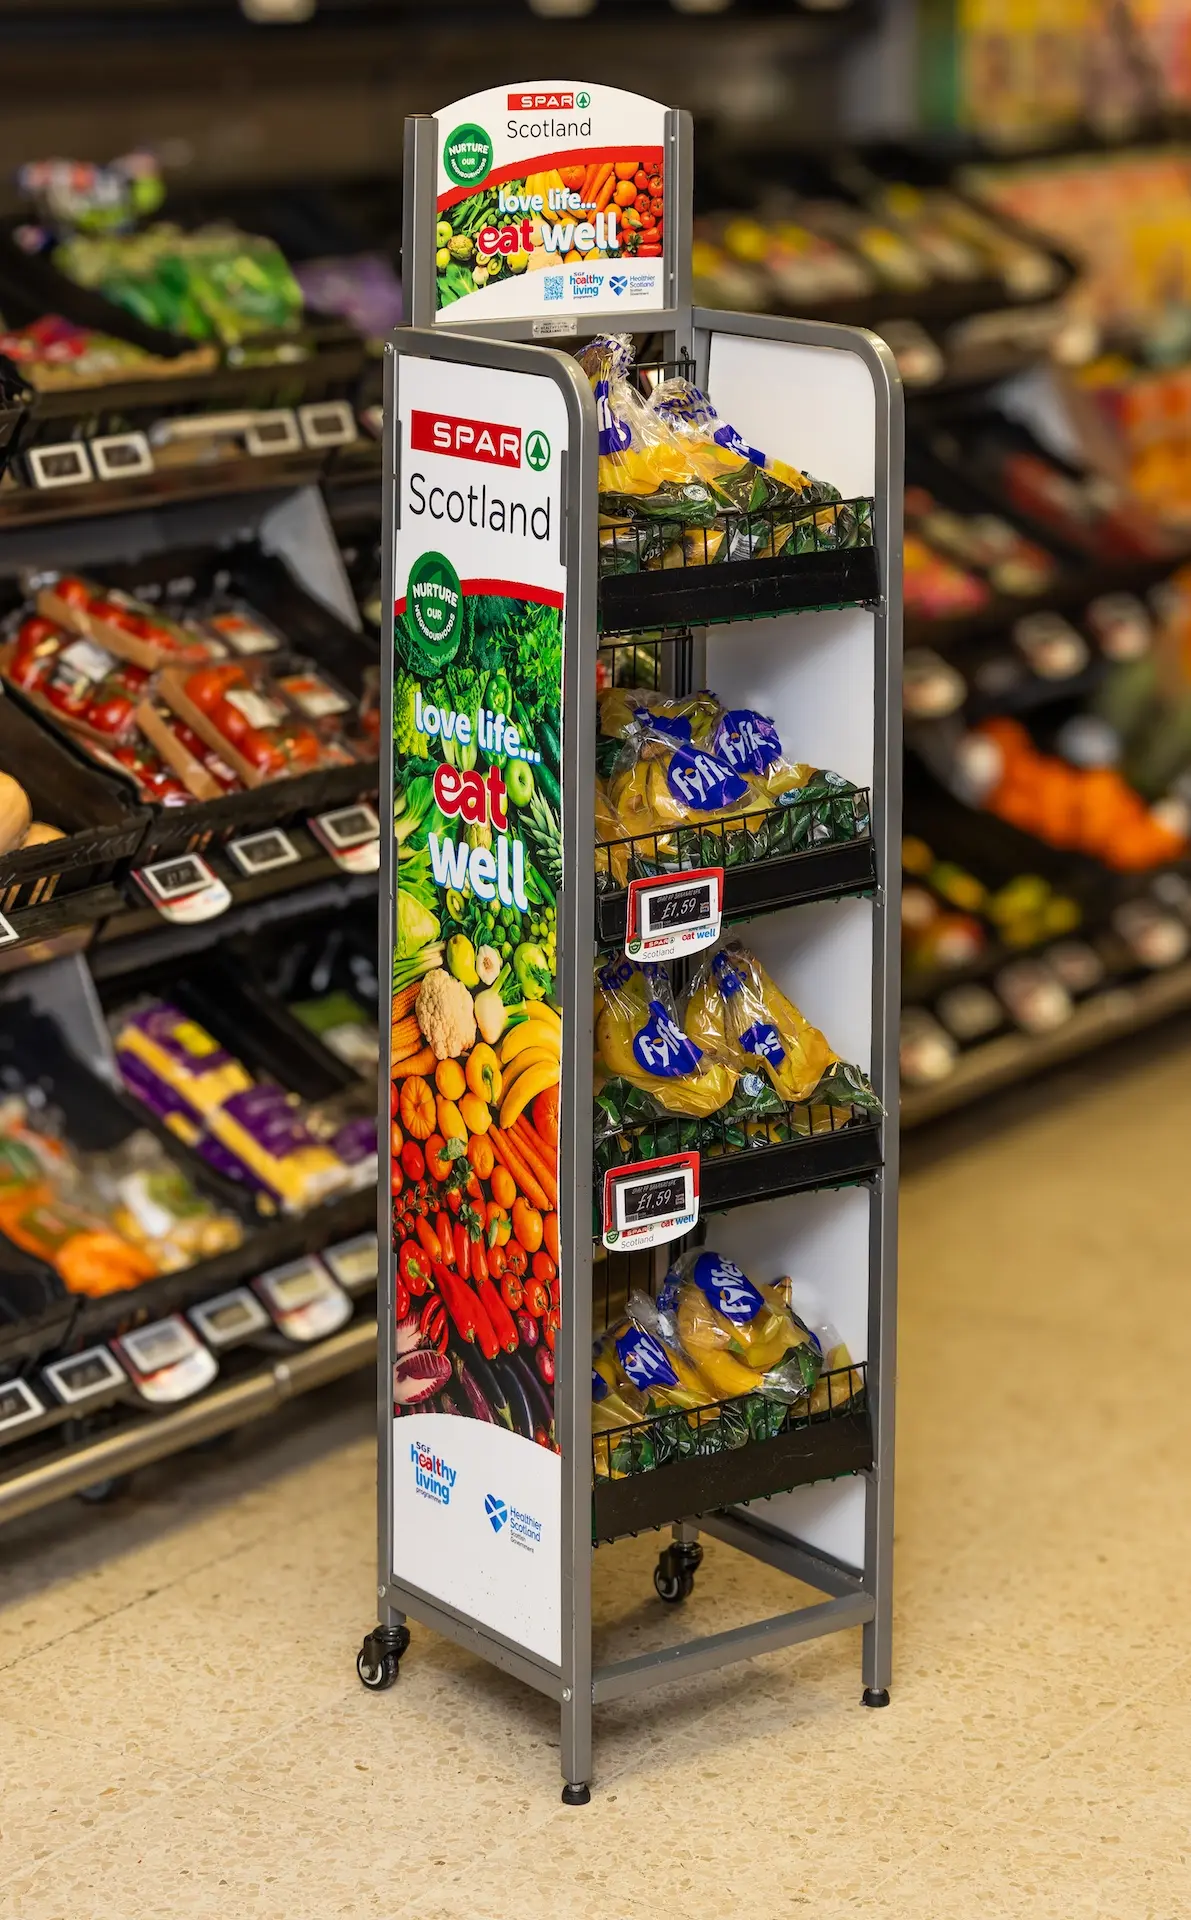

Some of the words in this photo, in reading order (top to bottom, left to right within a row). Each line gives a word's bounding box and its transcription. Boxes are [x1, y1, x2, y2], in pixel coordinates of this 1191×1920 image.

[521, 95, 573, 109] SPAR
[506, 118, 592, 139] Scotland
[448, 143, 489, 156] NURTURE
[498, 190, 543, 214] love
[548, 188, 597, 211] life...
[477, 218, 534, 255] eat
[541, 212, 619, 252] well
[569, 274, 604, 286] healthy
[573, 285, 599, 296] living
[433, 421, 520, 461] SPAR
[409, 472, 551, 541] Scotland
[412, 582, 459, 608] NURTURE
[414, 603, 456, 642] NEIGHBOURHOODS
[427, 608, 443, 620] OUR
[415, 691, 471, 746] love
[478, 708, 541, 766] life...
[433, 762, 508, 833] eat
[428, 831, 529, 913] well
[661, 898, 697, 920] £1.59
[648, 938, 669, 948] SPAR
[697, 928, 716, 939] well
[642, 947, 675, 960] Scotland
[636, 1189, 672, 1211] £1.59
[675, 1215, 695, 1225] well
[621, 1234, 655, 1249] Scotland
[415, 1441, 431, 1454] SGF
[411, 1443, 457, 1487] healthy
[415, 1487, 442, 1504] programme
[416, 1466, 449, 1505] living
[510, 1505, 542, 1531] Healthier
[510, 1518, 541, 1542] Scotland
